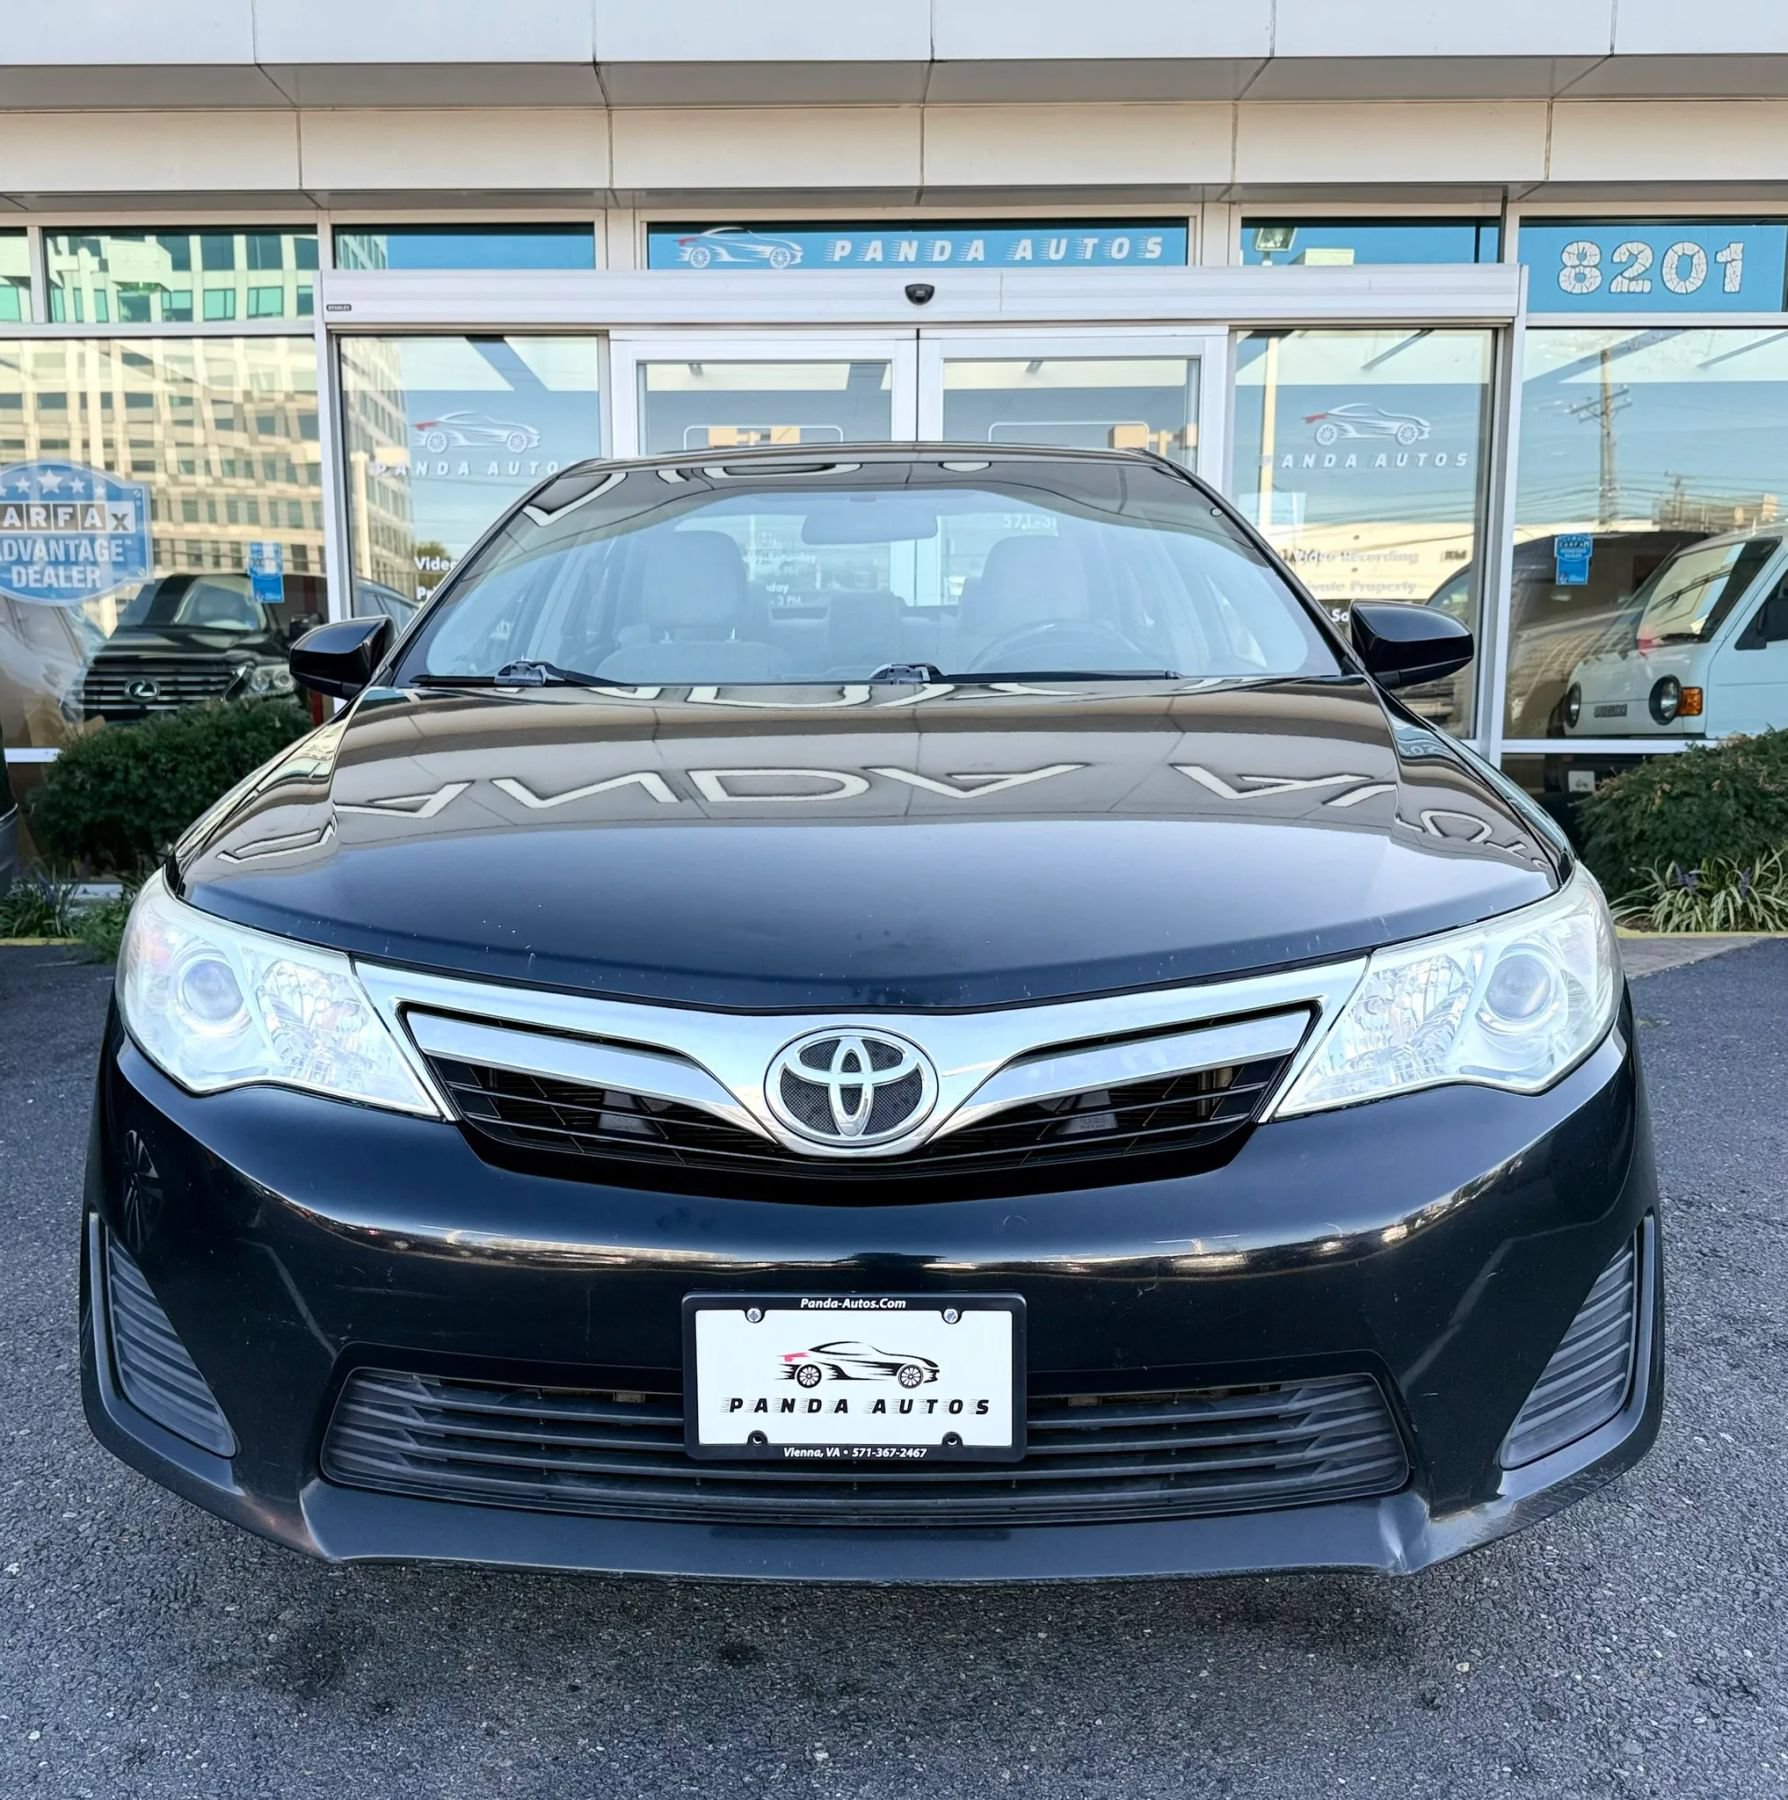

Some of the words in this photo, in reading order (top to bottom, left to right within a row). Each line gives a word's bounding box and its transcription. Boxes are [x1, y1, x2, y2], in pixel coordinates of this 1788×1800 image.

[826, 239, 985, 262] PANDA
[1006, 236, 1163, 261] AUTOS
[1557, 240, 1745, 295] 8201
[371, 460, 471, 476] PANDA
[487, 460, 578, 477] AUTO
[1373, 452, 1469, 468] AUTOS
[0, 506, 129, 532] ARFAX
[0, 538, 124, 562] DVANTAGE
[11, 565, 101, 589] DEALER
[799, 1298, 907, 1310] Panda-Autos.Com
[723, 1397, 849, 1415] PANDA
[863, 1398, 990, 1416] AUTOS
[783, 1447, 824, 1459] Vienna,
[825, 1448, 841, 1458] VA
[851, 1447, 928, 1459] 571-367-2467
